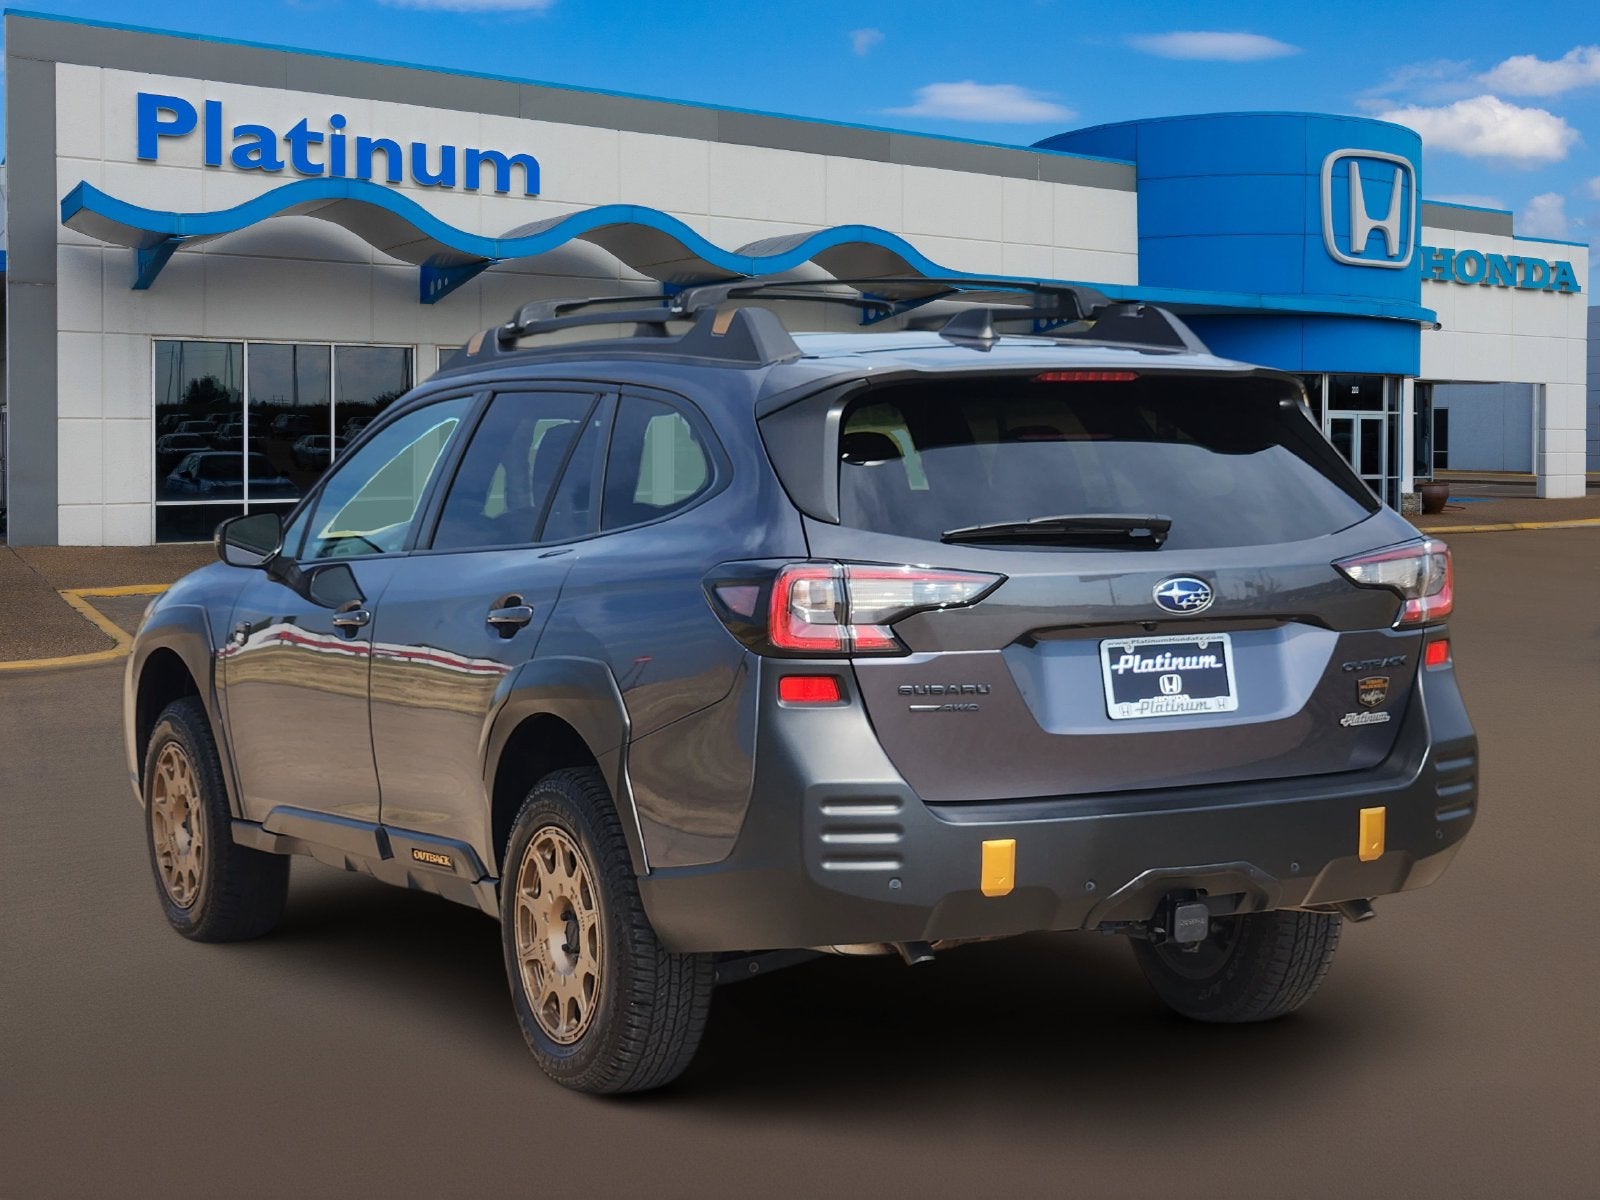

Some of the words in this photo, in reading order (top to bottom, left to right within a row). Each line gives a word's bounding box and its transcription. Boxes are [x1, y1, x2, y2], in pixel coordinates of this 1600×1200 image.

[137, 92, 541, 196] Platinum
[1421, 246, 1581, 293] HONDA
[1111, 652, 1224, 675] Platinum
[897, 683, 991, 696] SUBARU
[940, 703, 980, 712] AWD
[1135, 698, 1212, 716] Platinum
[1340, 711, 1391, 727] Platinum
[413, 849, 452, 867] OUTBACK
